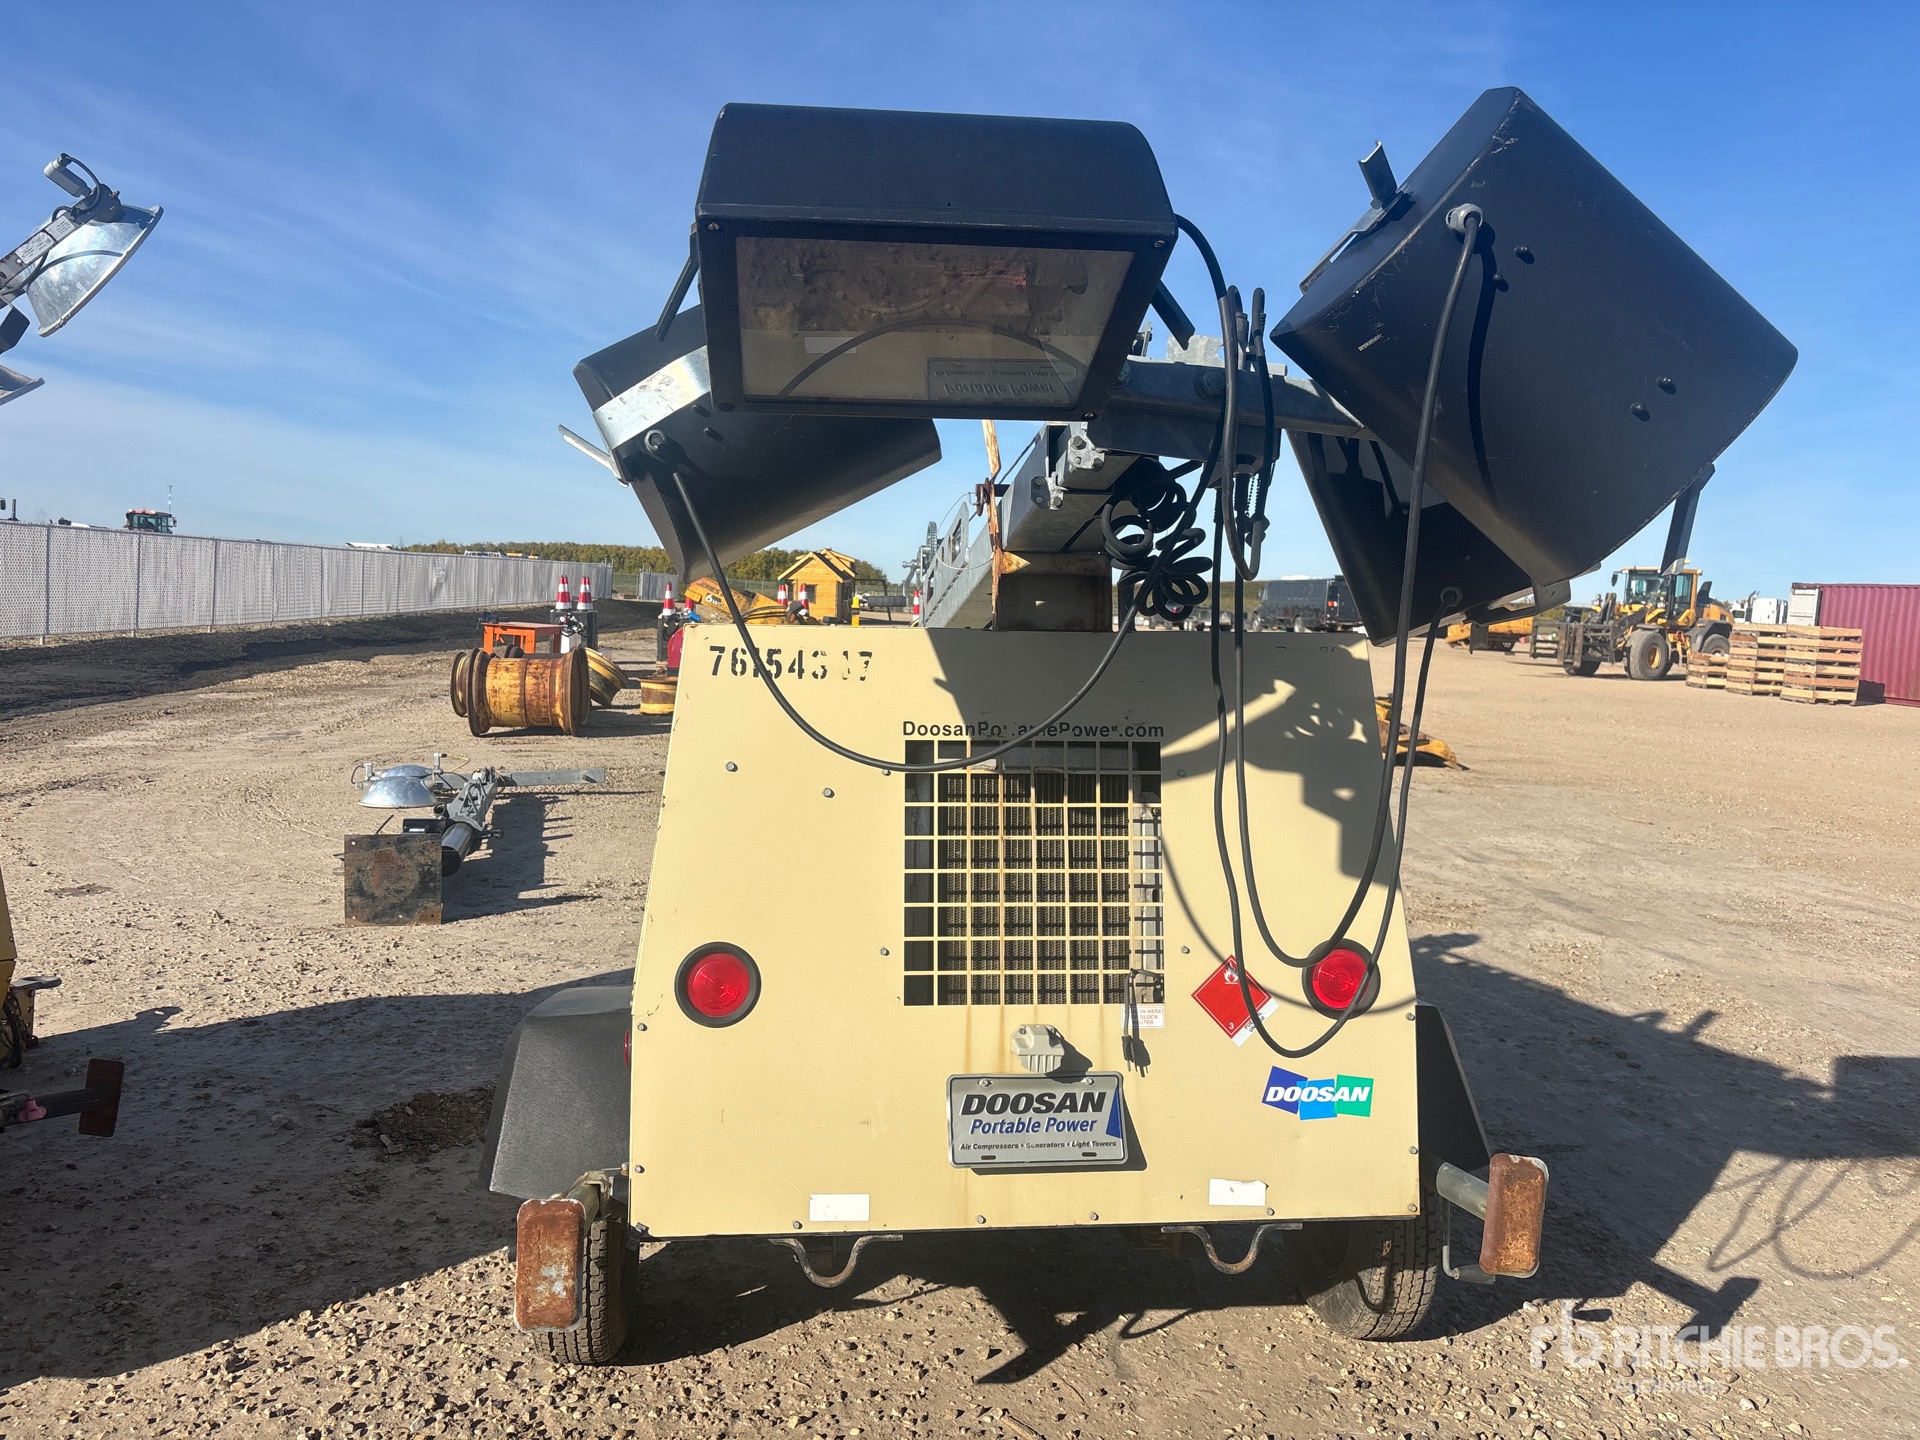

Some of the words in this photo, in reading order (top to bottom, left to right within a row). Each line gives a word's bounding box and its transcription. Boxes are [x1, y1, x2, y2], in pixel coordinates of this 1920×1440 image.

[1228, 1022, 1235, 1030] 3
[1266, 1086, 1371, 1102] DOOSAN
[961, 1092, 1106, 1116] DOOSAN
[970, 1116, 1040, 1135] Portable
[1045, 1117, 1097, 1133] Power
[973, 1143, 1019, 1151] Compressors
[1071, 1140, 1090, 1148] Light
[1092, 1140, 1117, 1148] Towers
